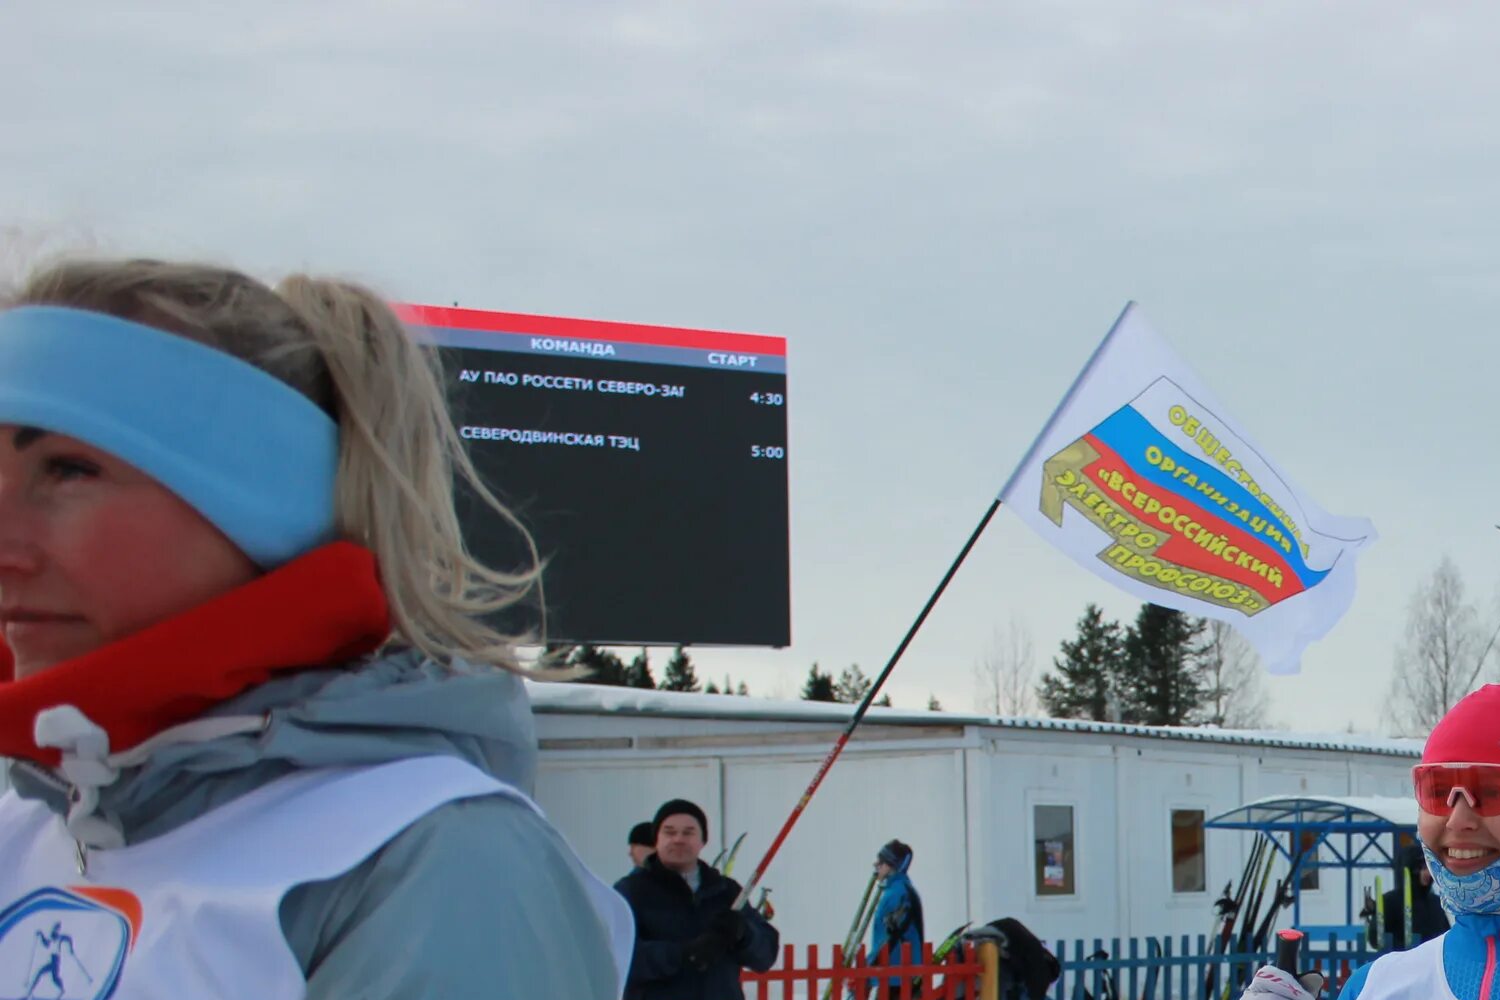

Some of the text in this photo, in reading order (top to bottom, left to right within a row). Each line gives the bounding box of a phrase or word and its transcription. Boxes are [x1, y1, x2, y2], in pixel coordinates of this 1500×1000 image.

[530, 338, 616, 356] КОМАНДА
[707, 352, 758, 368] СТАРТ
[459, 369, 481, 382] АУ
[484, 371, 518, 386] ПАО
[522, 374, 594, 392] РОССЕТИ
[750, 392, 784, 405] 4:30
[460, 426, 640, 451] СЕВЕРОДВИНСКАЯ ТЭЦ
[750, 445, 784, 459] 5:00
[1055, 469, 1158, 548] ЭЛЕКТРО
